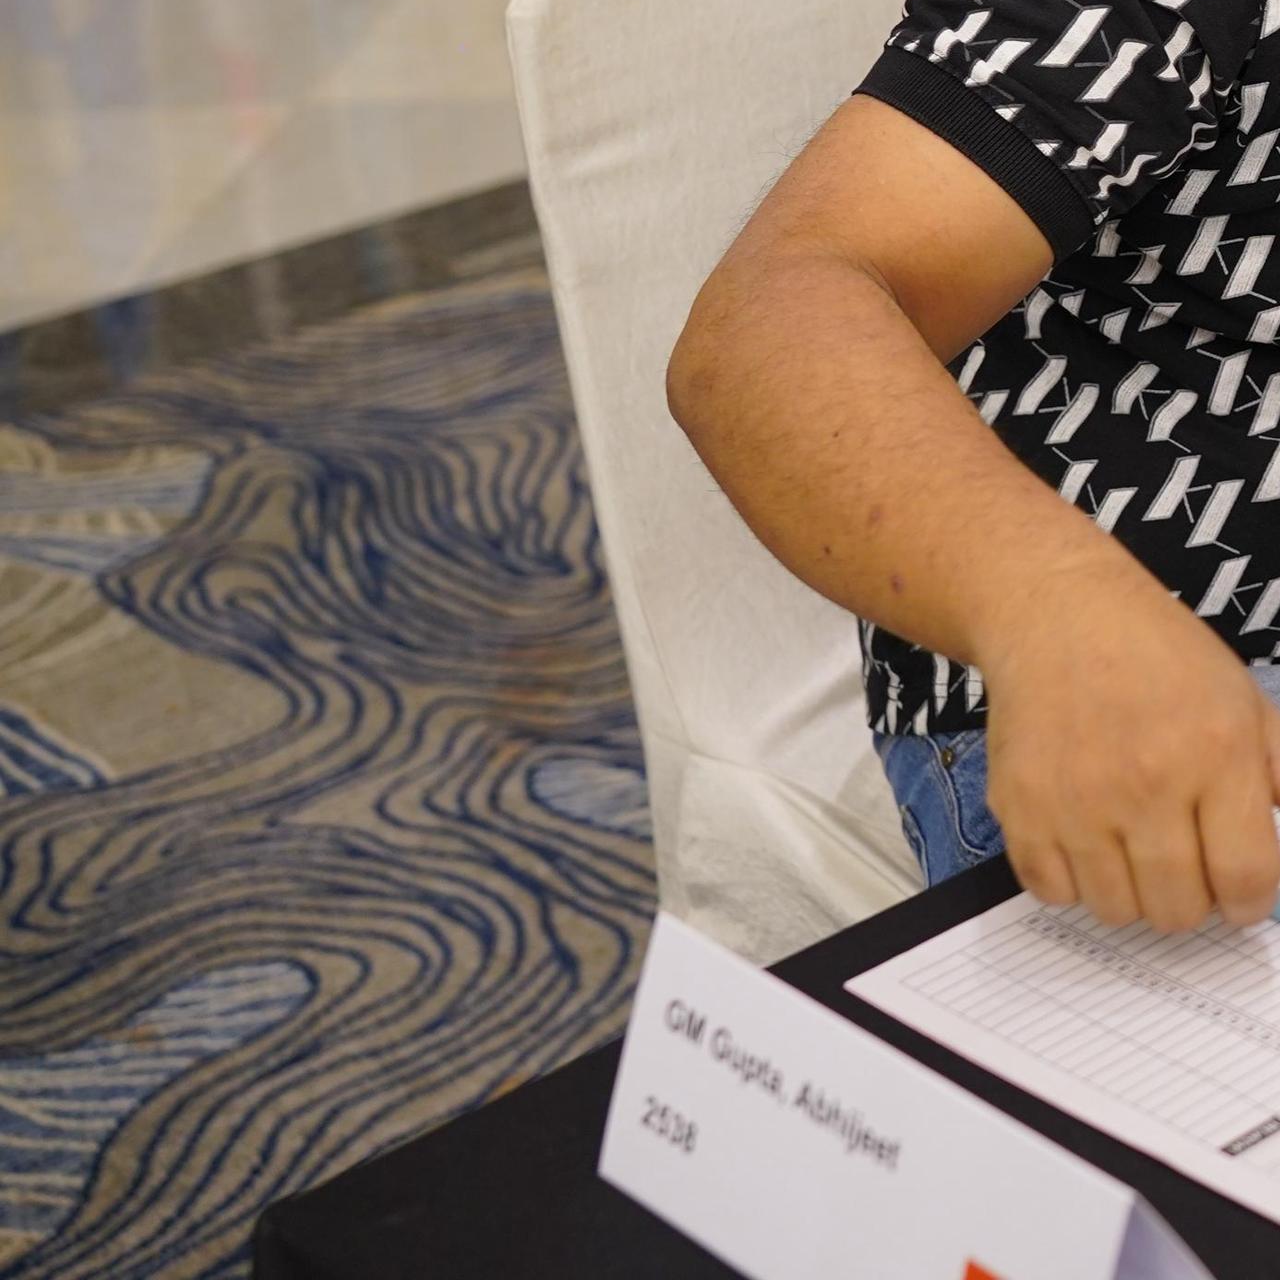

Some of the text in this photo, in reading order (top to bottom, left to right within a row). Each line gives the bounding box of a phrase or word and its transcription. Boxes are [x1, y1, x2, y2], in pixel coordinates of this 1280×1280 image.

[664, 999, 902, 1170] GM Gupta, Abhijeet
